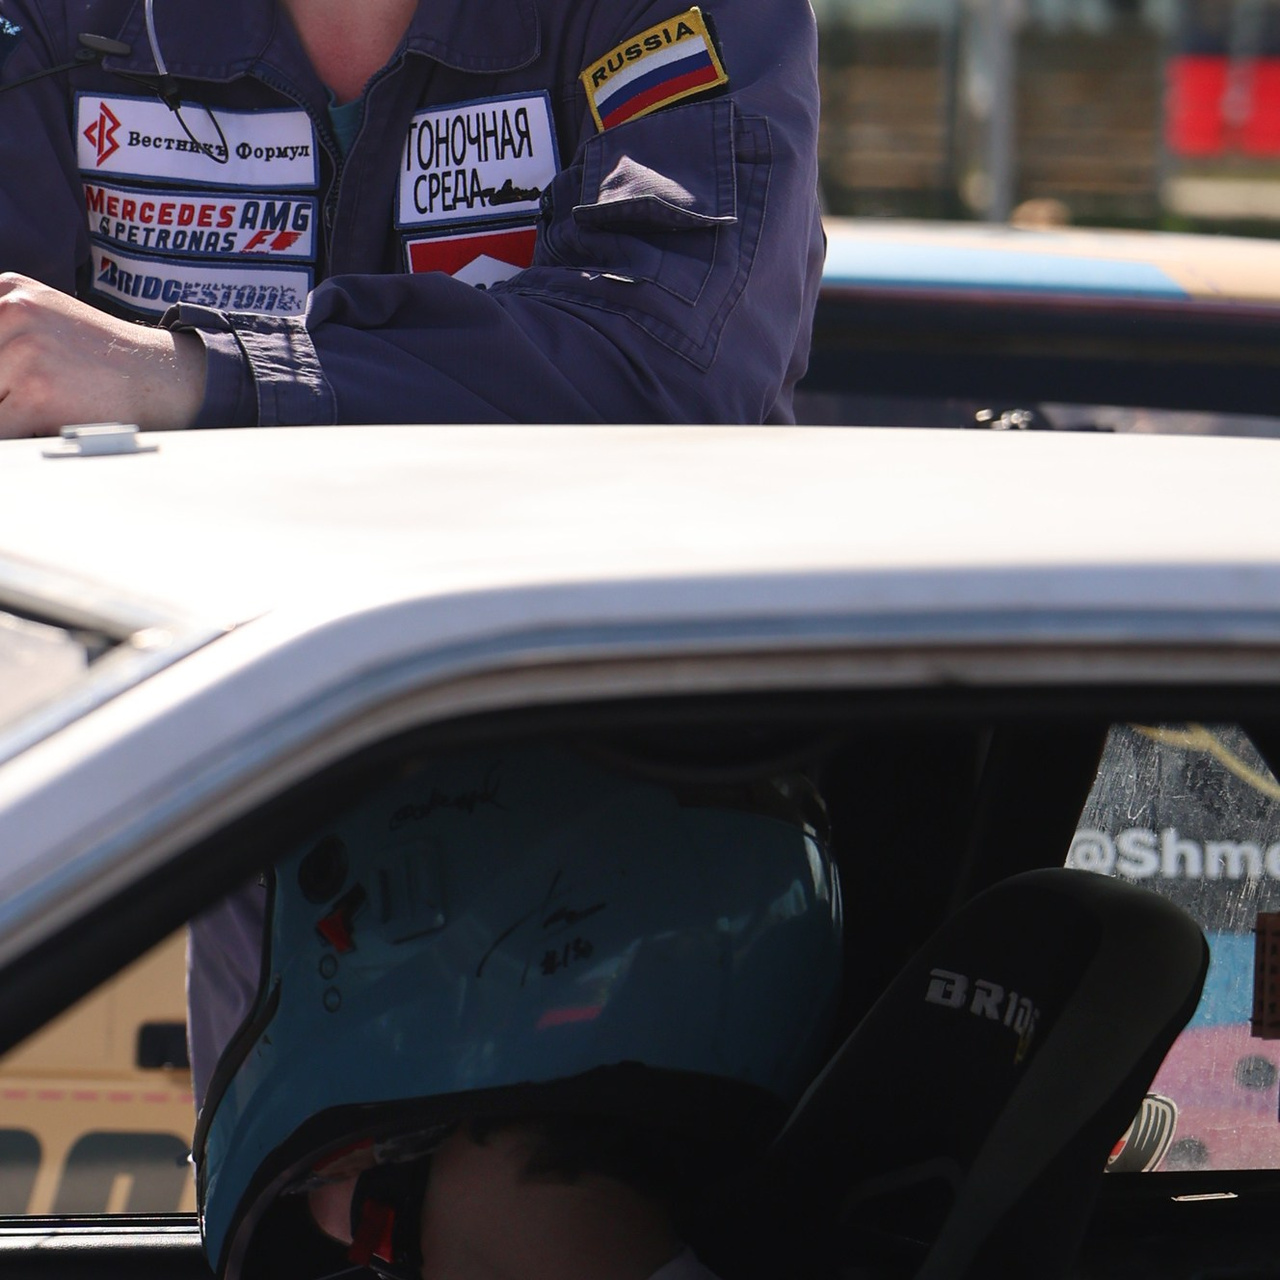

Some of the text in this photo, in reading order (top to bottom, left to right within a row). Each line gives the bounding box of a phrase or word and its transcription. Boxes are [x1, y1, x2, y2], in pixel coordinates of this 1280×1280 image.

[592, 22, 694, 87] RUSSIA
[407, 107, 533, 171] ГОНОЧНАЯ
[86, 186, 311, 231] MERCEDES AMG
[413, 168, 486, 214] СРЕДА
[115, 223, 237, 252] PETRONAS
